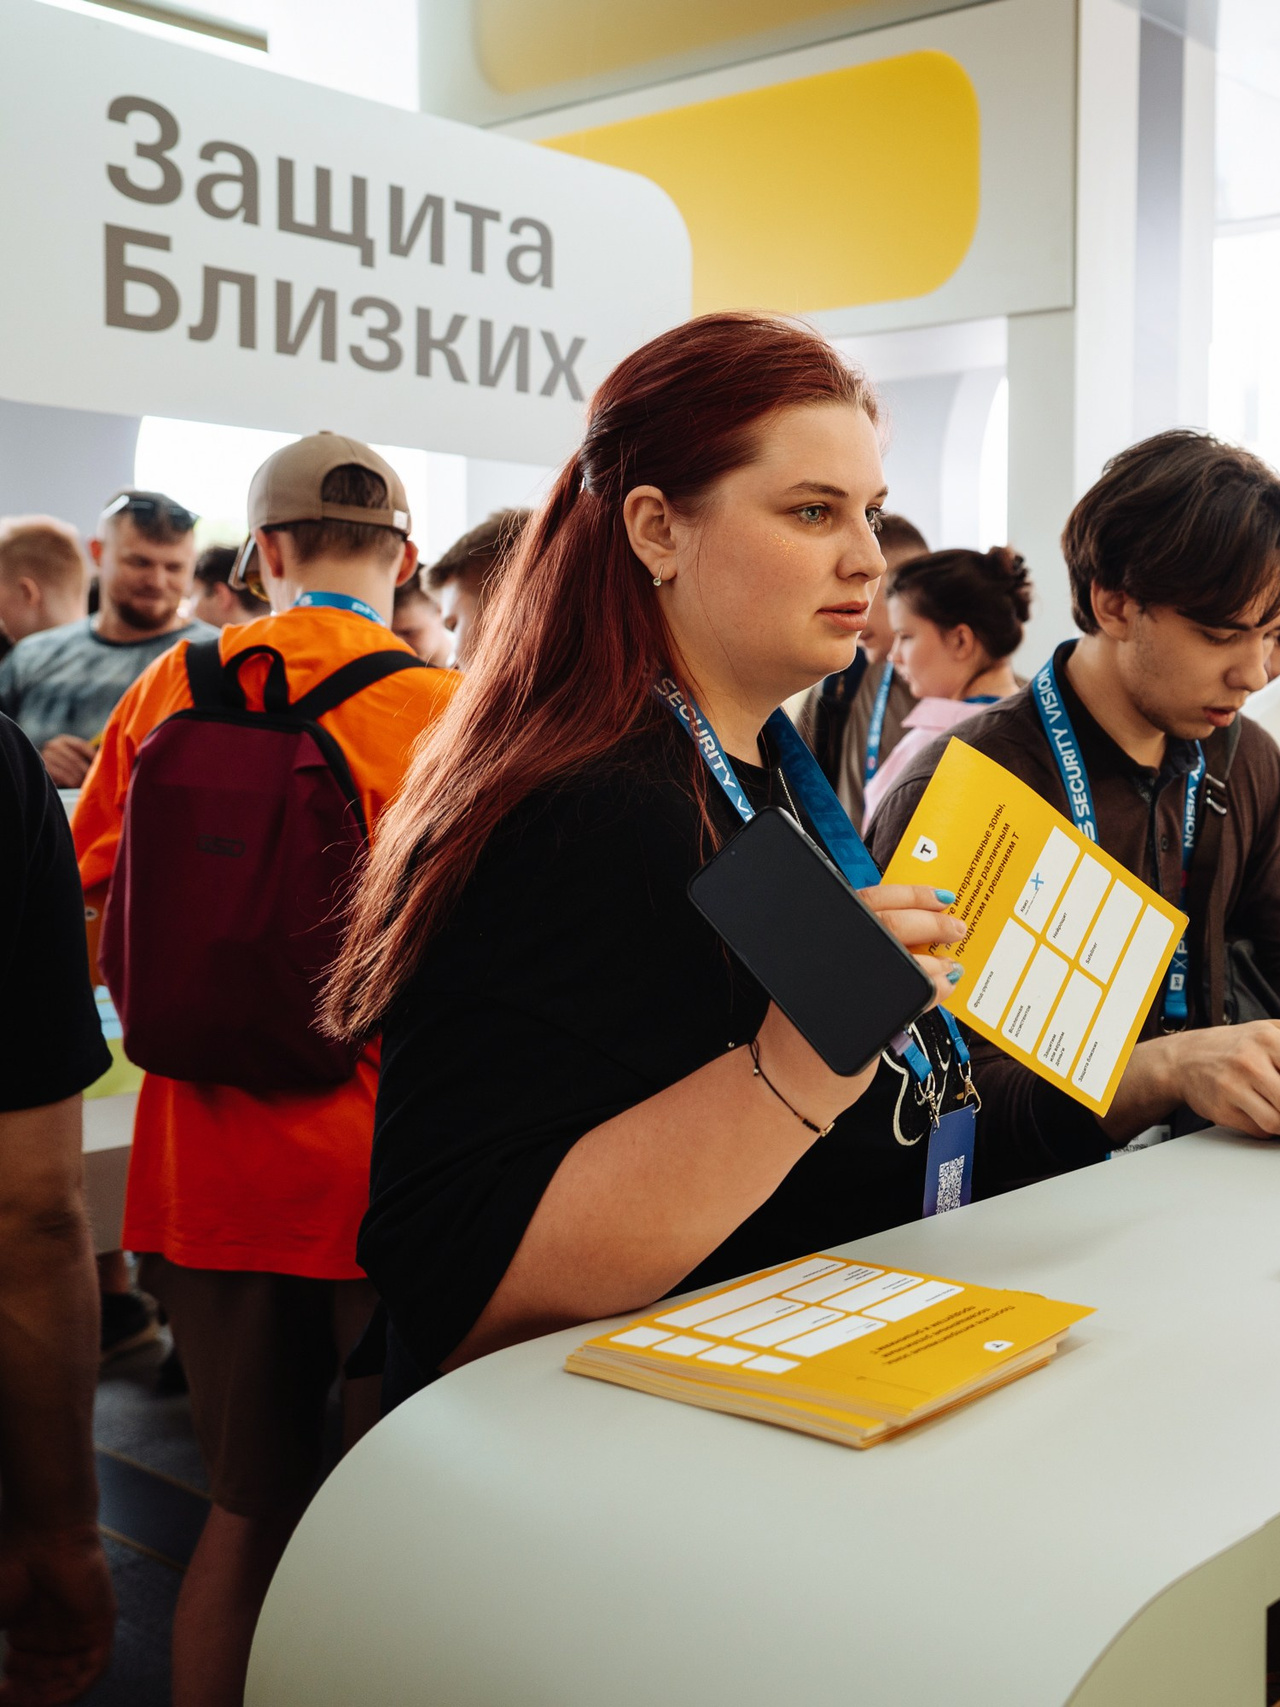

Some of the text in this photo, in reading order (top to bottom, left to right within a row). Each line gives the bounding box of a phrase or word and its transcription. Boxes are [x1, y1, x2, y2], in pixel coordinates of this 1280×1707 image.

[105, 94, 556, 290] Защита
[104, 223, 588, 402] Близких
[653, 677, 737, 789] SECURITY
[1036, 667, 1063, 725] VISION
[1051, 726, 1091, 819] SECURITY
[1184, 786, 1198, 849] VISION
[953, 830, 992, 906] интерактивные
[988, 804, 1006, 831] зоны,
[955, 832, 1020, 957] продуктам и решениям Т
[981, 823, 1010, 880] различным
